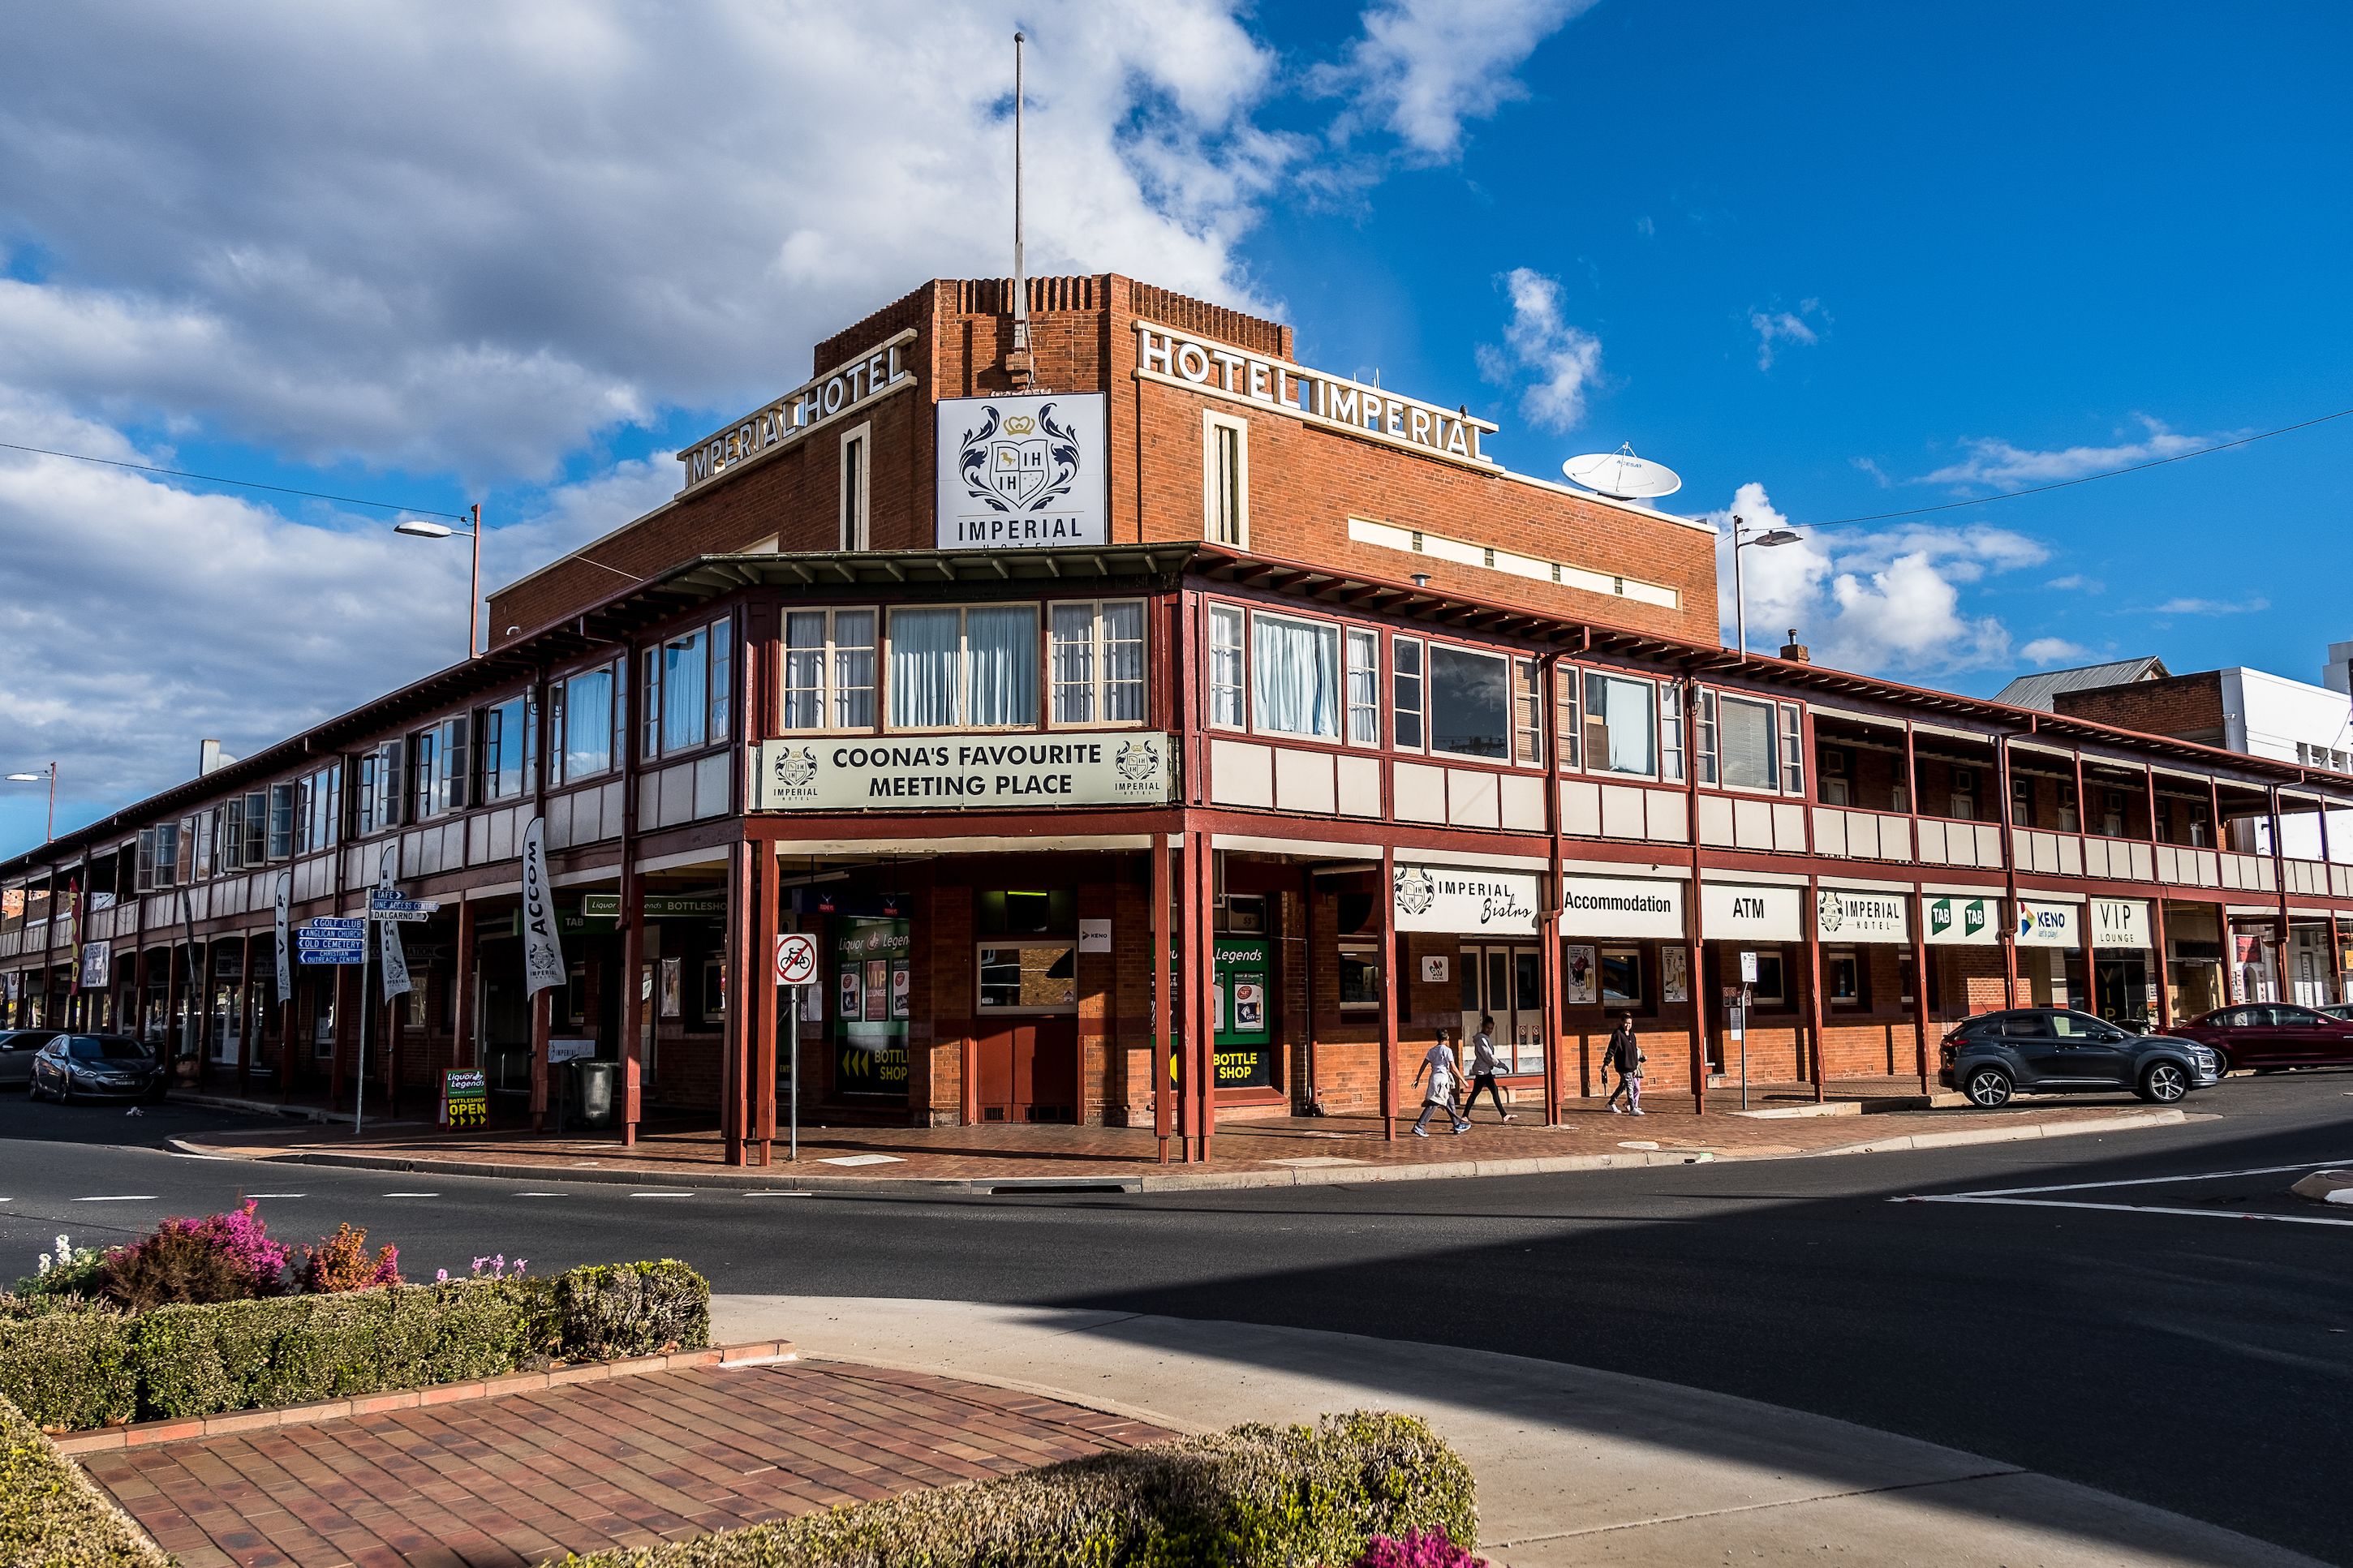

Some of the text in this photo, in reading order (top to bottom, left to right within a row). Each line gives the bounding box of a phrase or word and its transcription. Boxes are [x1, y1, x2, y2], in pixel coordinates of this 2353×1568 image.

[1142, 329, 1492, 463] HOTEL IMPERIAL
[685, 346, 905, 488] IMPERIAL HOTEL
[1024, 452, 1041, 466] IH
[1000, 475, 1017, 490] IH
[958, 518, 1082, 541] IMPERIAL
[832, 744, 1101, 768] COONA'S FAVOURITE
[773, 788, 818, 796] IMPERIAL
[868, 774, 1072, 797] MEETING PLACE
[1115, 782, 1159, 790] IMPERIAL
[528, 841, 548, 937] ACCOM
[1439, 881, 1511, 897] IMPERIAL
[374, 900, 437, 910] UNE ACCESS CENTRE
[591, 900, 727, 912] Liquor ends BOTTLESHO
[1481, 893, 1533, 924] Bistro
[1564, 891, 1671, 913] Accommodation
[1733, 897, 1765, 918] ATM
[1845, 900, 1899, 918] IMPERIAL
[374, 911, 413, 920] DALGARNO
[565, 917, 584, 927] TAB
[1933, 908, 1983, 925] TAB TAB
[2037, 912, 2065, 928] KENO
[2100, 904, 2131, 929] VIP
[320, 919, 362, 928] GOLF CLUB
[1856, 921, 1890, 930] HOTEL
[305, 929, 362, 938] ANGLICAN CHURCH
[2100, 934, 2134, 942] LOUNGE
[322, 940, 361, 948] CEMETERY
[839, 934, 910, 953] Liquor Legen
[1215, 947, 1263, 964] Legends
[867, 970, 886, 987] VIP
[867, 989, 886, 997] LOUNGE
[1213, 1052, 1258, 1066] BOTTLE
[447, 1072, 473, 1081] Liquor
[880, 1066, 908, 1080] SHOP
[1219, 1066, 1252, 1079] SHOP
[451, 1079, 485, 1089] Legends
[449, 1103, 487, 1115] OPEN
